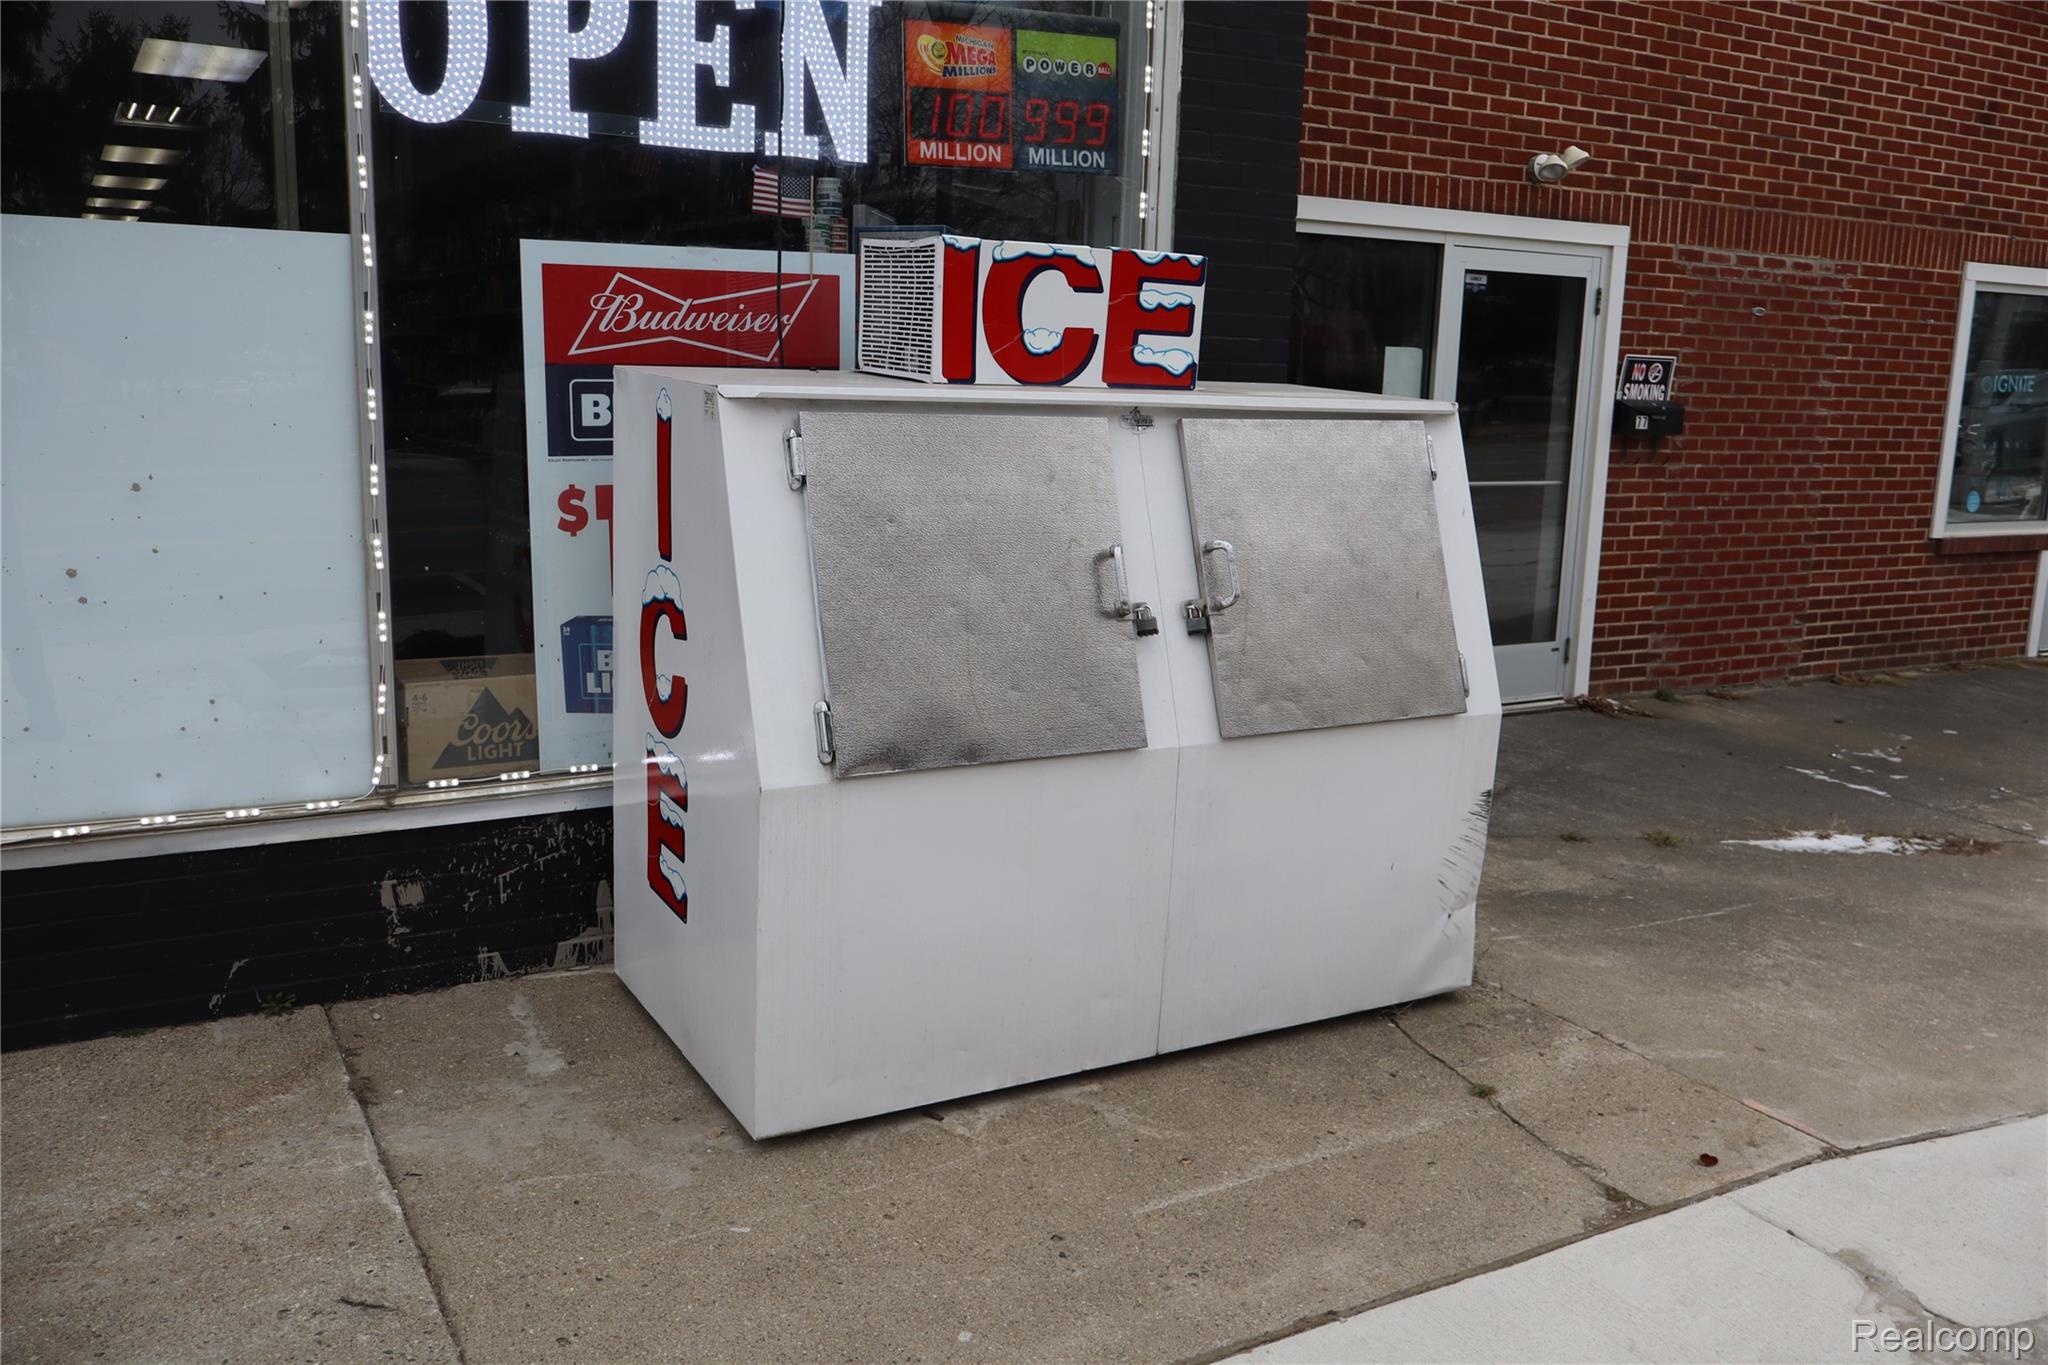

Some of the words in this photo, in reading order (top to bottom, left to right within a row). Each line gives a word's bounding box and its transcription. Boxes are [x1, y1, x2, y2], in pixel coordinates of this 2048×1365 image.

[944, 41, 996, 66] MEGA
[955, 34, 994, 50] MICHIGAN
[367, 0, 882, 163] OPEN
[942, 65, 996, 78] MILLIONS
[930, 93, 1007, 139] 100
[1022, 98, 1111, 147] 999
[919, 141, 1002, 162] MILLION
[1028, 147, 1106, 168] MILLION
[590, 293, 792, 333] Budweiser
[941, 234, 1208, 392] ICE
[1631, 363, 1647, 381] NO
[1623, 383, 1666, 401] SMOKING
[1992, 375, 2036, 393] IGNITE
[640, 386, 688, 925] ICE
[453, 713, 538, 747] Coors
[467, 741, 524, 761] LIGHT
